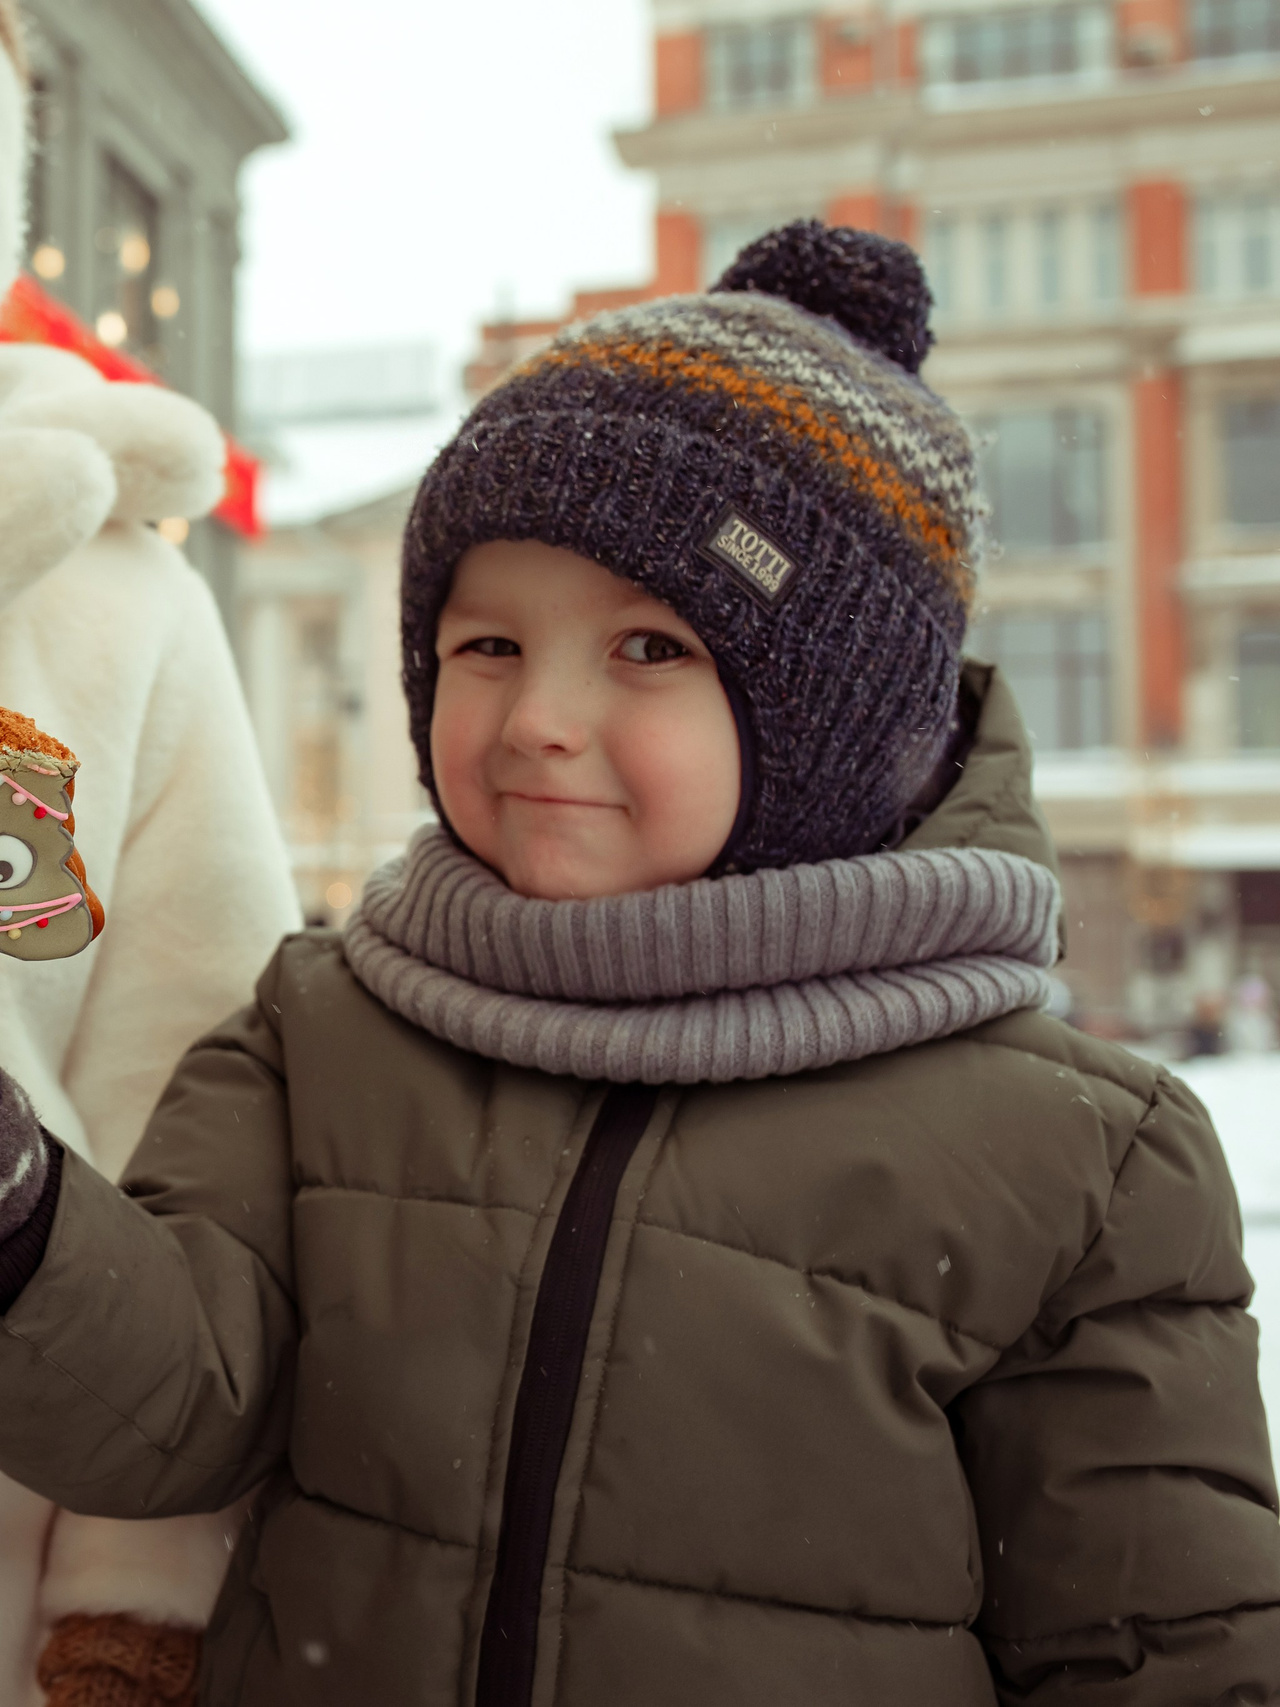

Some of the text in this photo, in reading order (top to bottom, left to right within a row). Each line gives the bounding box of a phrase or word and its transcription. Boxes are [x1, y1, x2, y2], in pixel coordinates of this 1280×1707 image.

[717, 535, 779, 592] SINCE 1999
[729, 519, 791, 580] TOTTI
